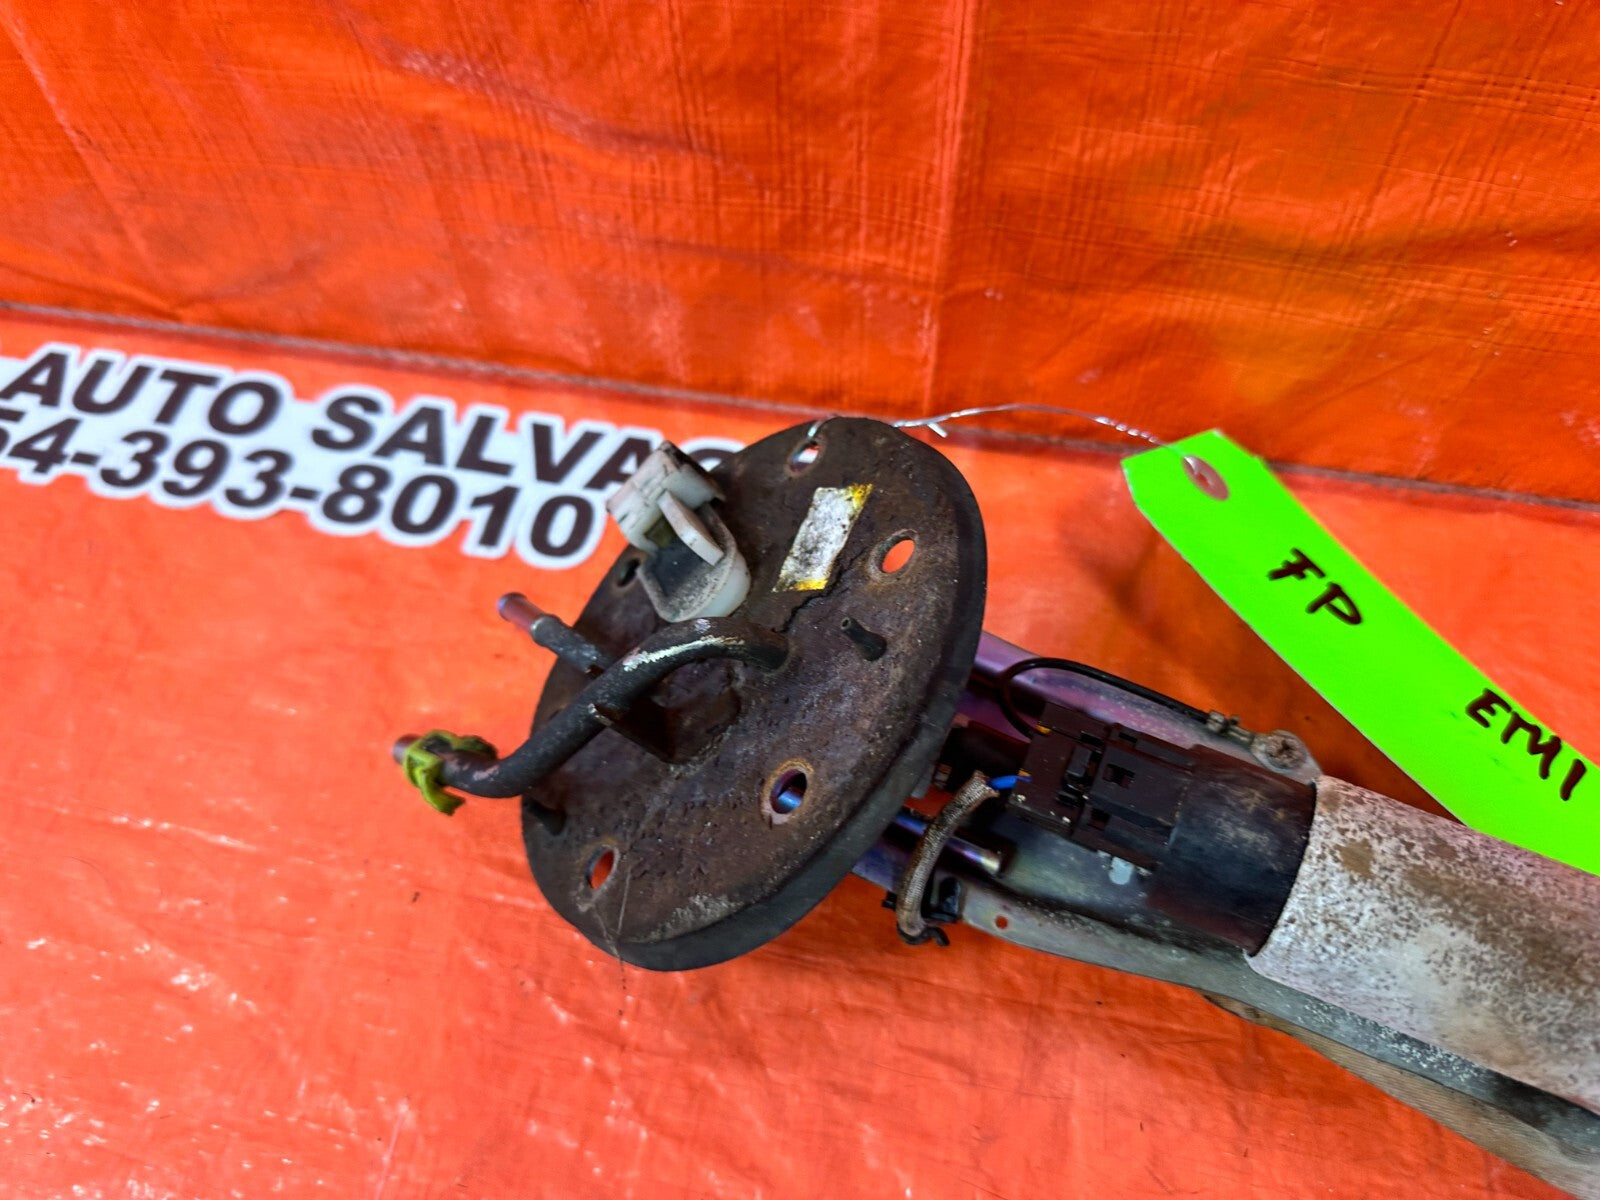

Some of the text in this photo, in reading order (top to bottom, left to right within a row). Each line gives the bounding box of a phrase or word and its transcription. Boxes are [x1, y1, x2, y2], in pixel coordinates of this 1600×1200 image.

[0, 352, 736, 490] AUTO SALVA
[1267, 548, 1362, 625] FP
